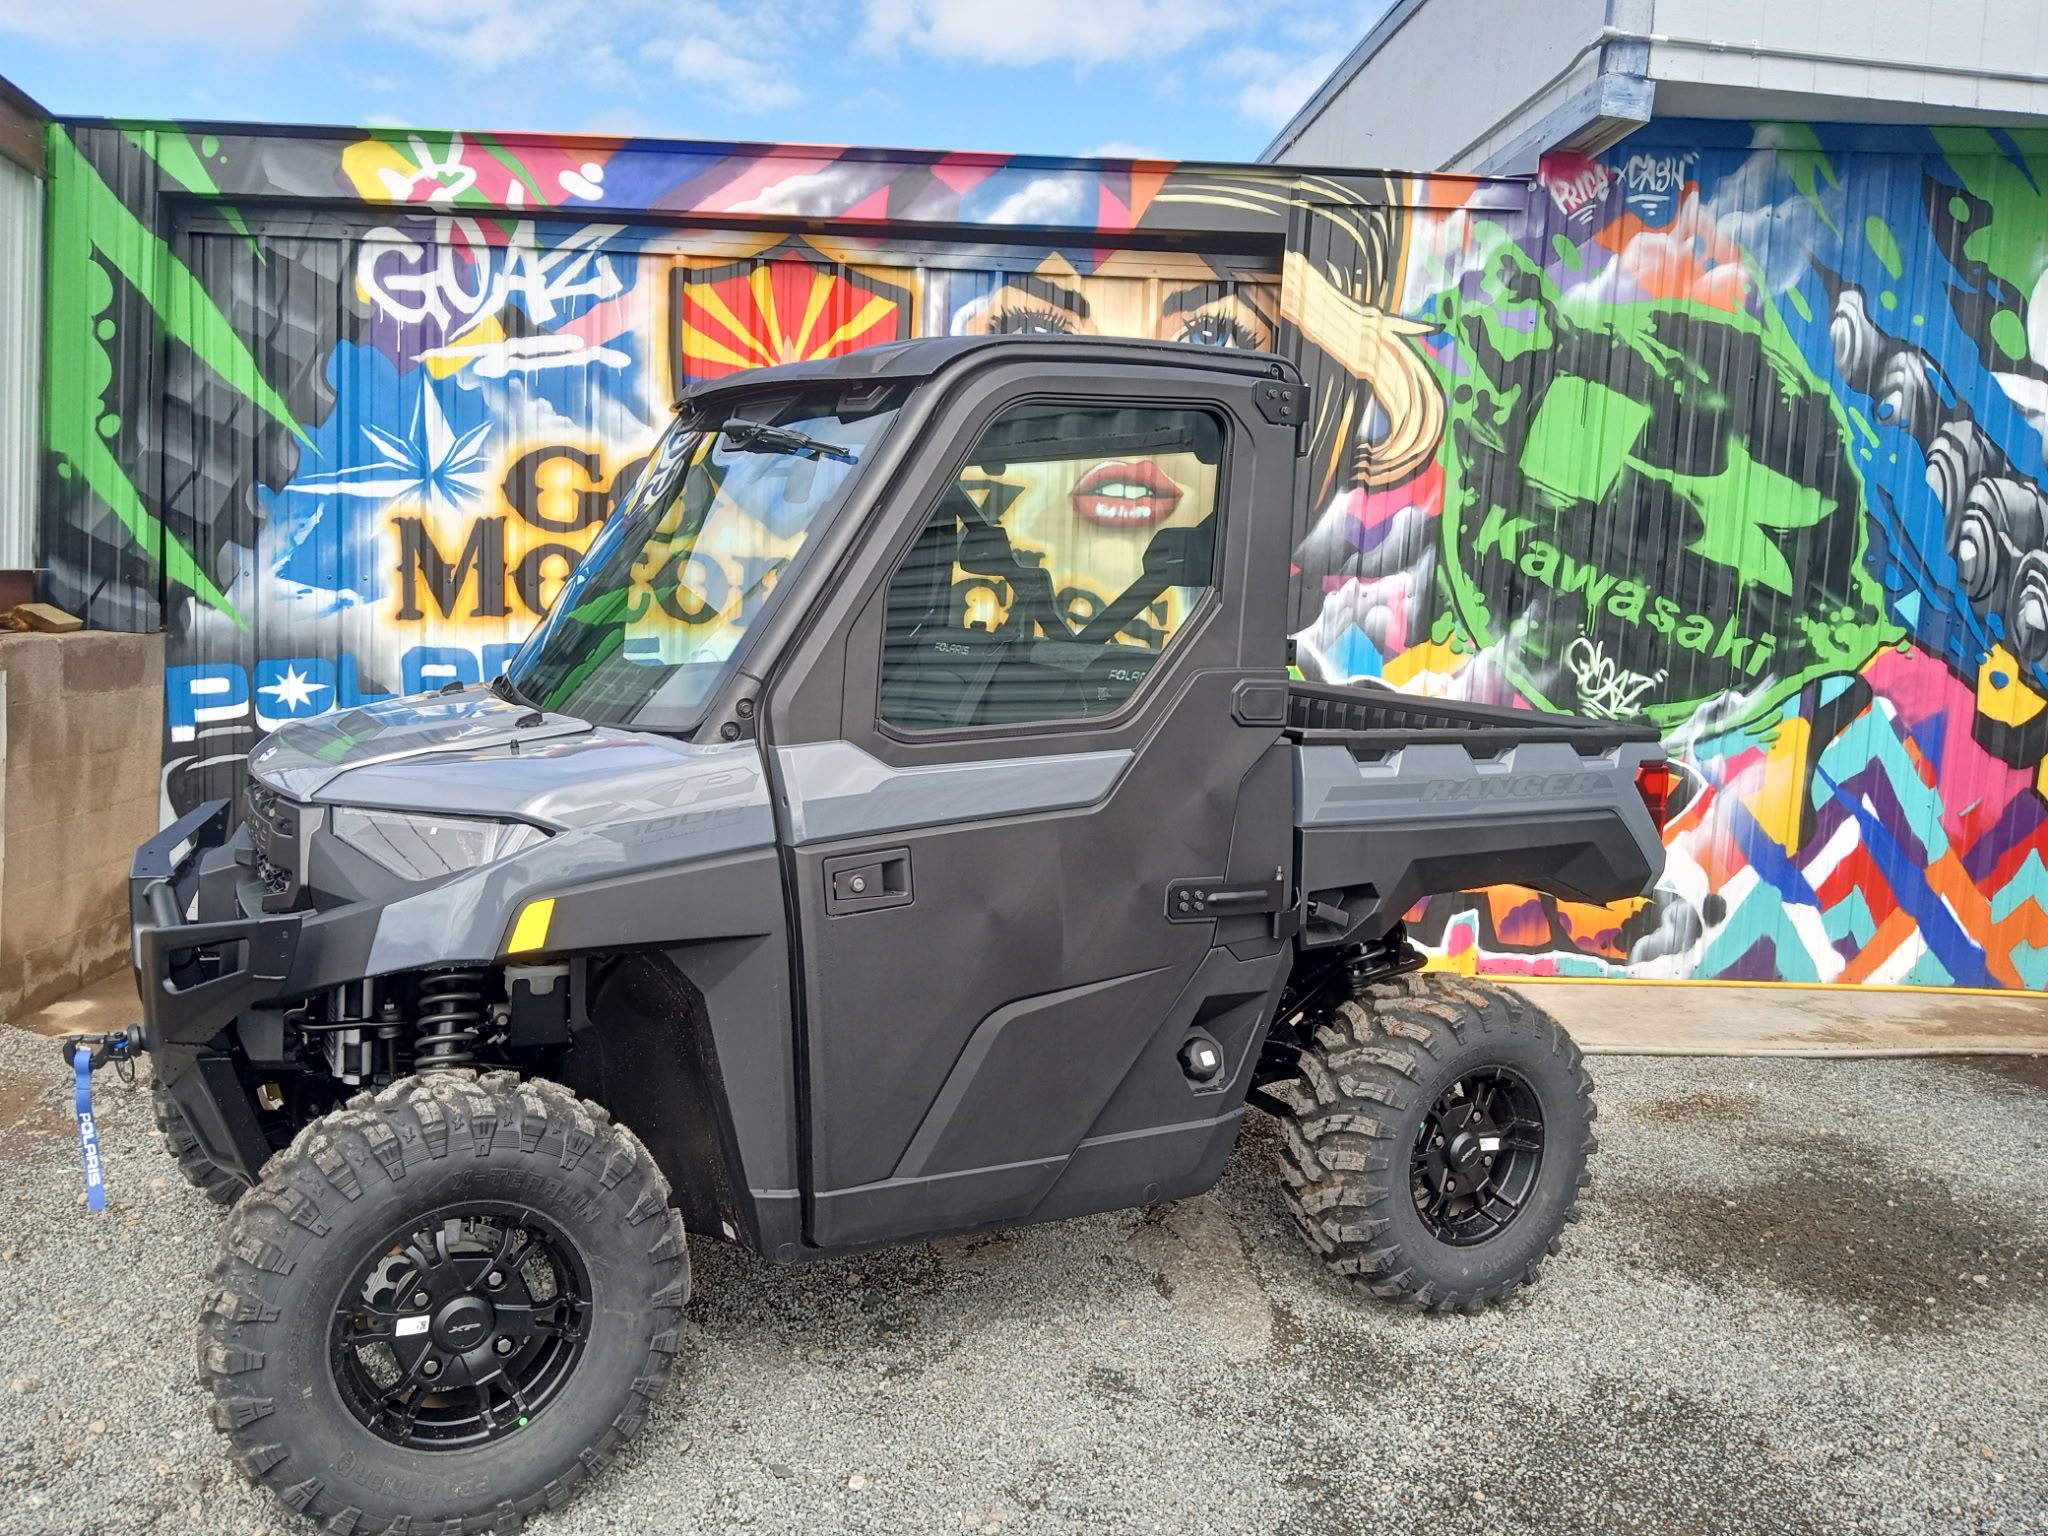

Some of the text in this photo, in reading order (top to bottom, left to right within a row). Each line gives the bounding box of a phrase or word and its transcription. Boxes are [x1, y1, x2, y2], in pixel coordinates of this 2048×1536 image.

[1472, 503, 1778, 677] Kawasaki
[933, 641, 971, 656] POLARIS
[1418, 771, 1602, 802] RANGER
[79, 1112, 101, 1187] POLARIS
[452, 1167, 602, 1223] X-TERRAIN
